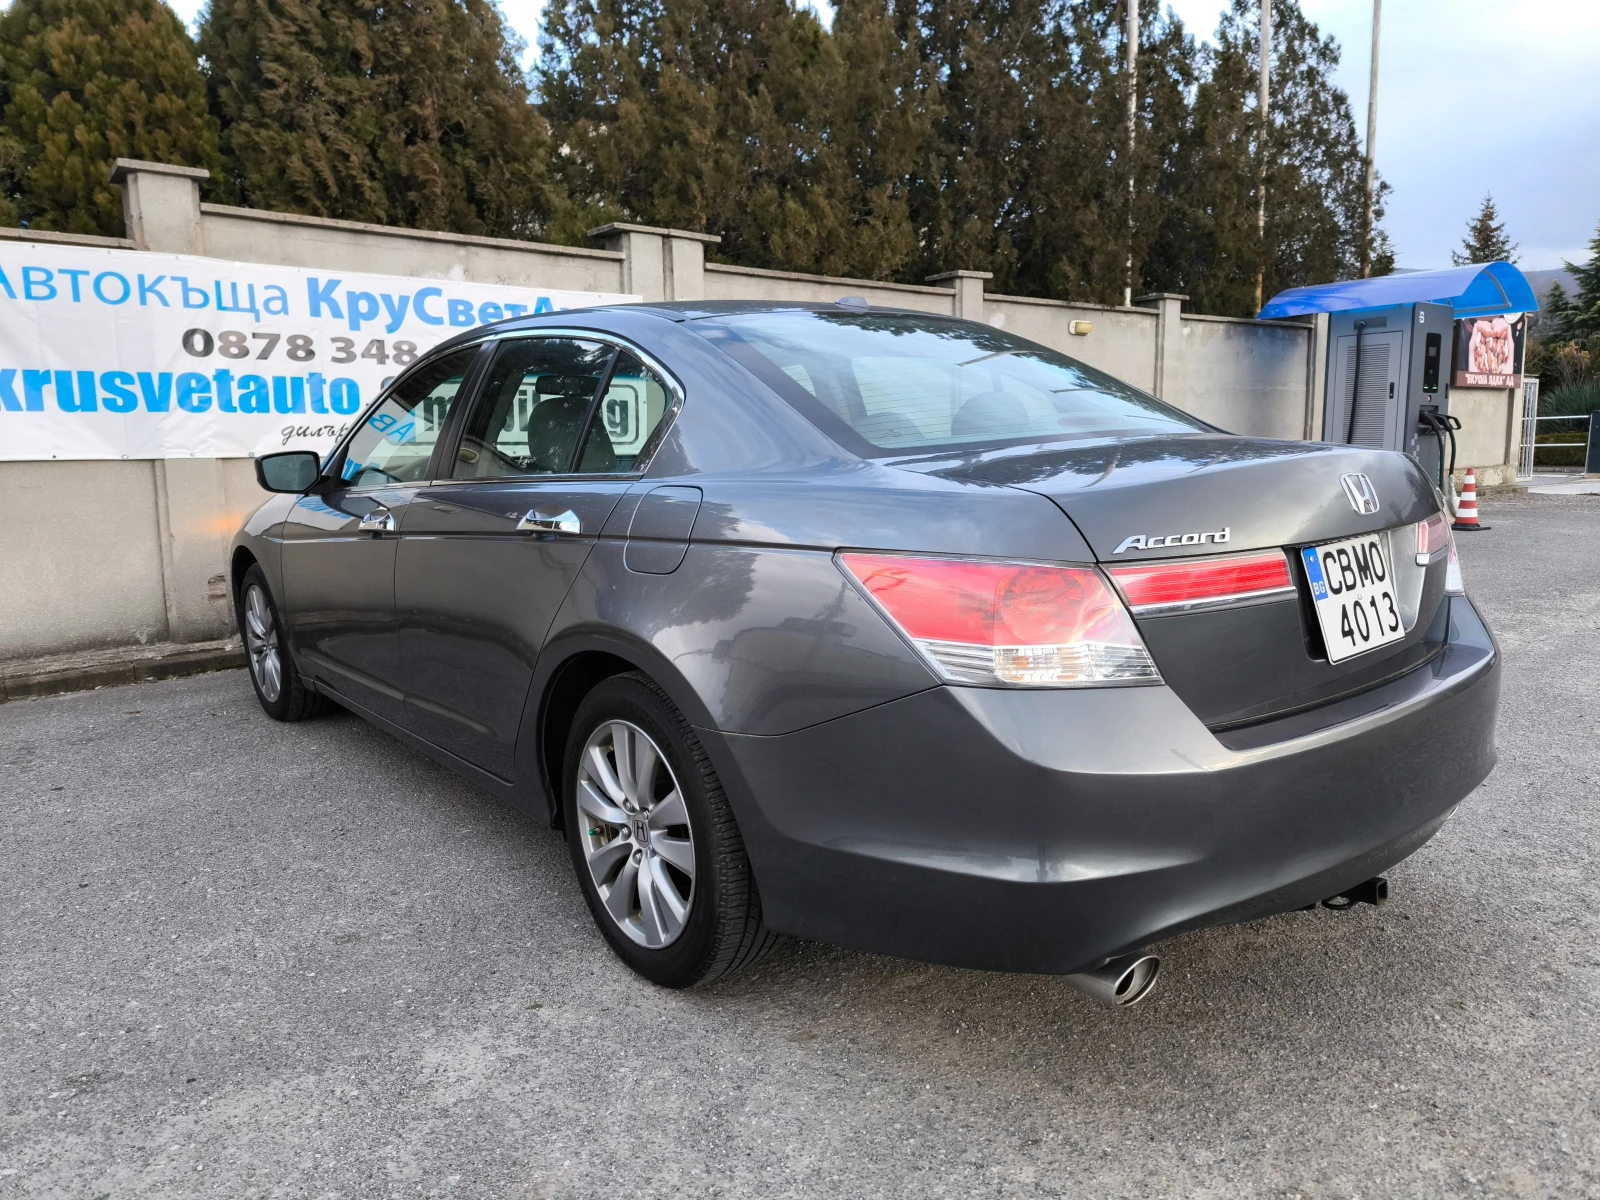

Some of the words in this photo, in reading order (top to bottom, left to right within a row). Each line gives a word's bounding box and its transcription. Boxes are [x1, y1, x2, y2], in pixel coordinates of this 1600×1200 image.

[182, 328, 316, 362] 0878
[329, 337, 419, 366] 348
[1112, 527, 1230, 555] Accord
[1313, 580, 1326, 595] BG
[1341, 591, 1399, 646] 4013
